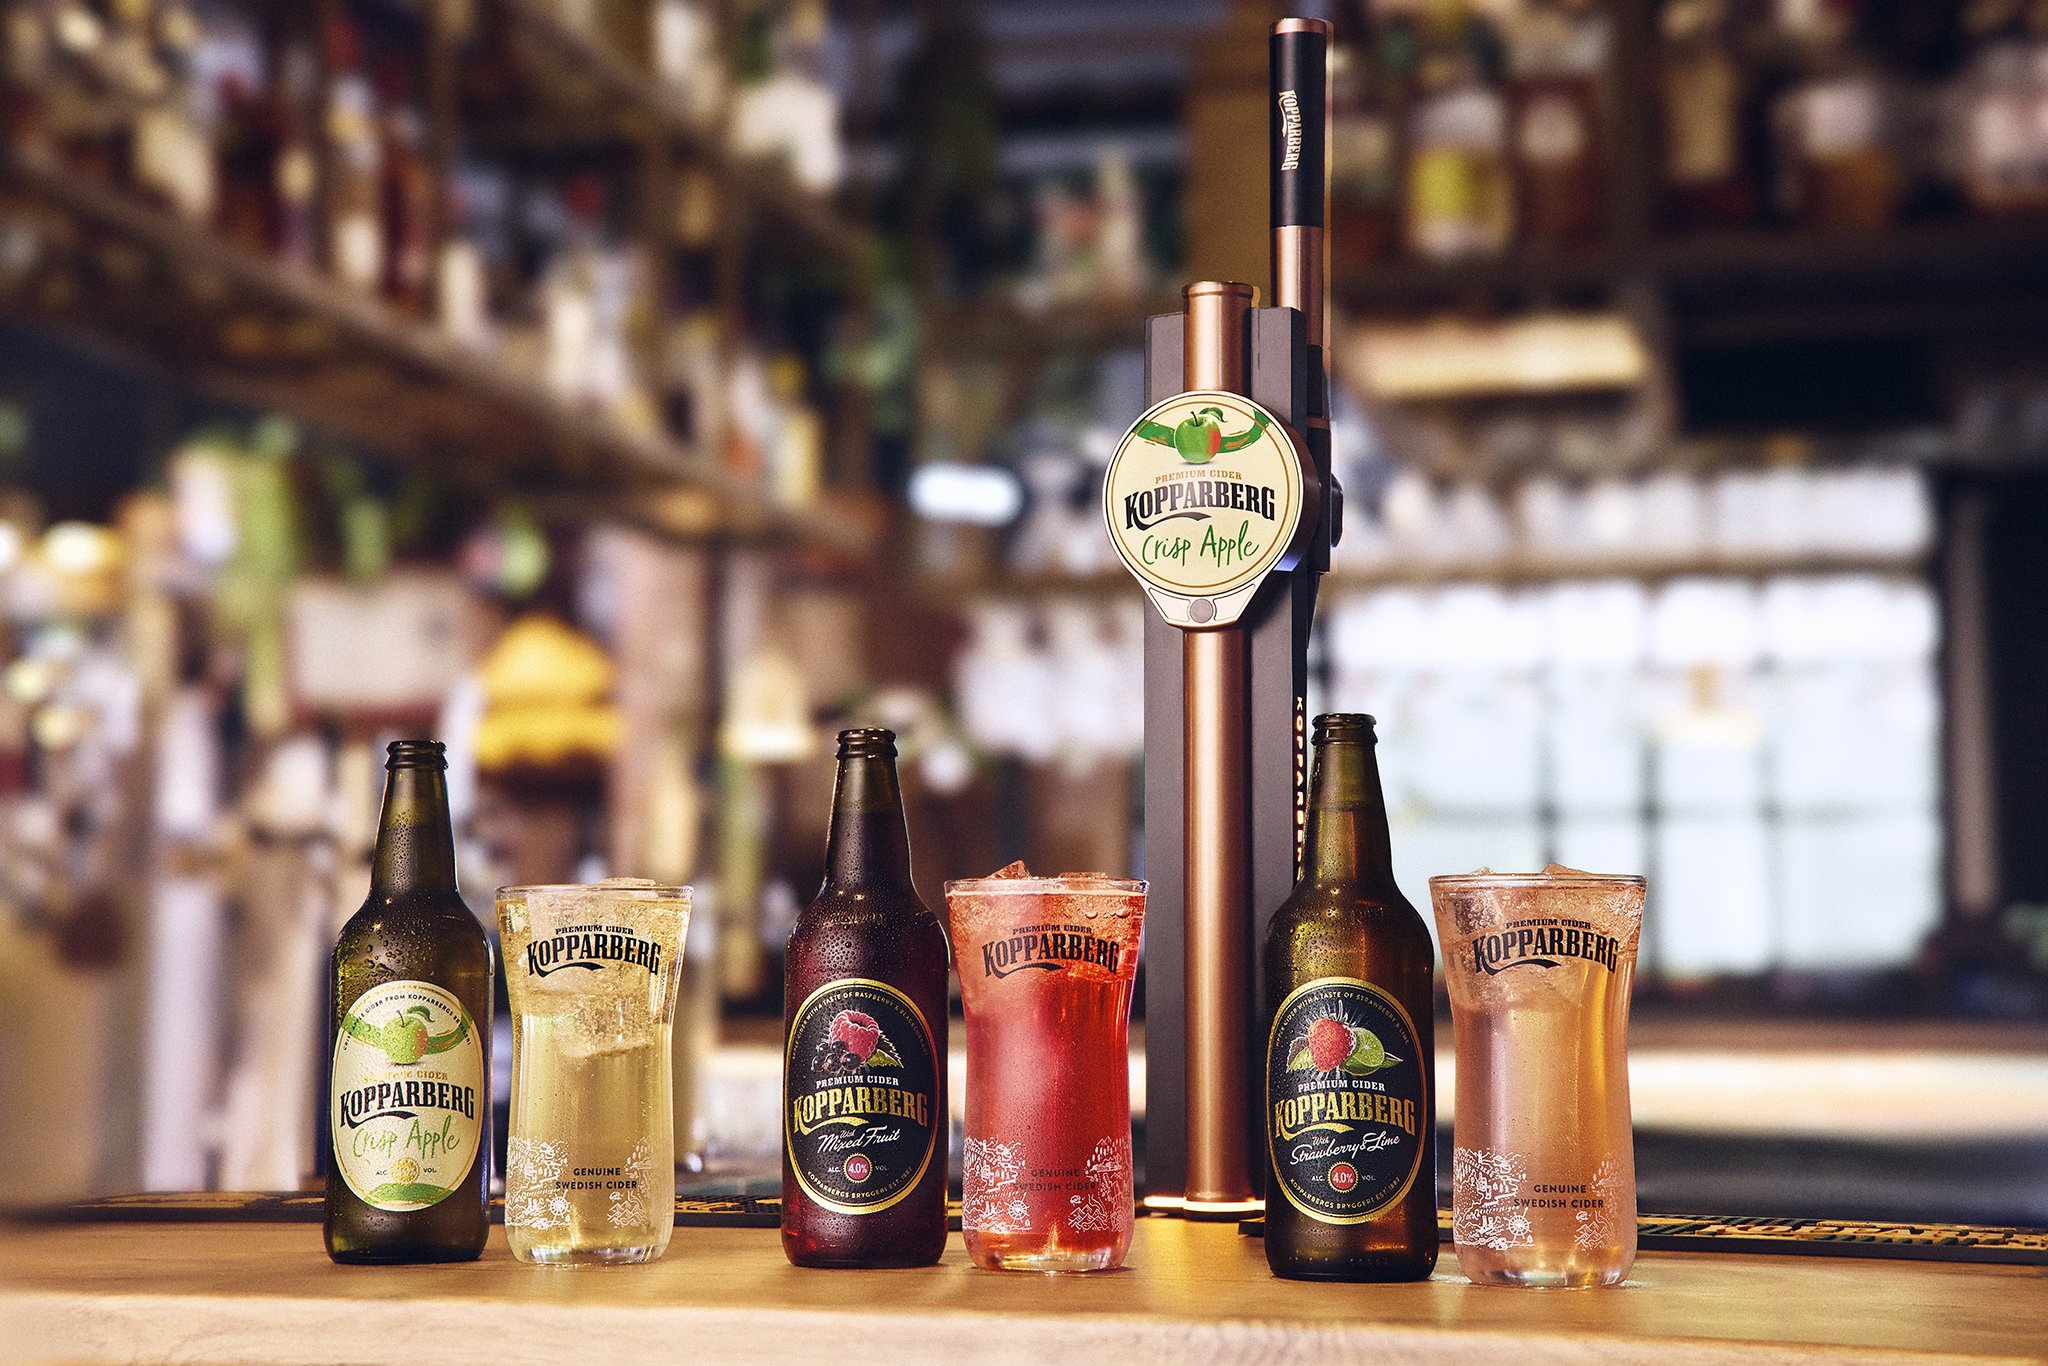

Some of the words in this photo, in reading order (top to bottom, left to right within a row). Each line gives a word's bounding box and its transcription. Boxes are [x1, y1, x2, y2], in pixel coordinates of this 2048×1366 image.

[1278, 90, 1302, 171] KOPPARBERG
[1155, 470, 1206, 484] PREMIUM
[1210, 470, 1242, 481] CIDER
[1124, 480, 1275, 531] KOPPARBERG
[1142, 535, 1191, 567] Crisp
[1200, 520, 1260, 568] Apple
[555, 924, 605, 935] PREMIUM
[606, 925, 634, 935] CIDER
[1012, 924, 1061, 935] PREMIUM
[1063, 925, 1093, 934] CIDER
[1506, 919, 1558, 929] PREMIUM
[1561, 919, 1592, 930] CIDER
[526, 934, 662, 978] KOPPARBERG
[982, 933, 1119, 979] KOPPARBERG
[1472, 927, 1619, 976] KOPPARBERG
[385, 994, 406, 1002] FROM
[408, 994, 454, 1016] KOPPARBERGS
[806, 1006, 819, 1020] WITH
[822, 994, 841, 1005] TASTE
[854, 991, 893, 1007] RASPBERRY
[1296, 997, 1315, 1010] WITH
[1319, 991, 1341, 1000] TASTE
[1356, 994, 1397, 1022] STRAWBERRY
[417, 1071, 448, 1080] CIDER
[816, 1075, 864, 1089] PREMIUM
[867, 1075, 899, 1086] CIDER
[1298, 1079, 1348, 1093] PREMIUM
[1352, 1080, 1386, 1091] CIDER
[340, 1081, 474, 1129] KOPPARBERG
[793, 1086, 927, 1136] KOPPARBERG
[1274, 1091, 1415, 1141] KOPPARBERG
[352, 1128, 398, 1159] Crisp
[405, 1115, 461, 1159] Apple
[817, 1133, 863, 1153] Mixed
[863, 1125, 901, 1147] Fruit
[1312, 1136, 1331, 1145] With
[573, 1167, 621, 1176] GENUINE
[848, 1163, 868, 1174] 4.0%
[1031, 1169, 1080, 1177] GENUINE
[555, 1181, 602, 1190] SWEDISH
[606, 1180, 637, 1189] CIDER
[807, 1170, 850, 1198] KOPPARBERGS
[1065, 1182, 1097, 1191] CIDER
[1333, 1172, 1354, 1184] 4.0%
[1290, 1178, 1334, 1209] KOPPARBERGS
[1336, 1197, 1375, 1210] BRYGGERI
[1534, 1184, 1587, 1193] GENUINE
[1514, 1199, 1567, 1208] SWEDISH
[1571, 1199, 1604, 1208] CIDER
